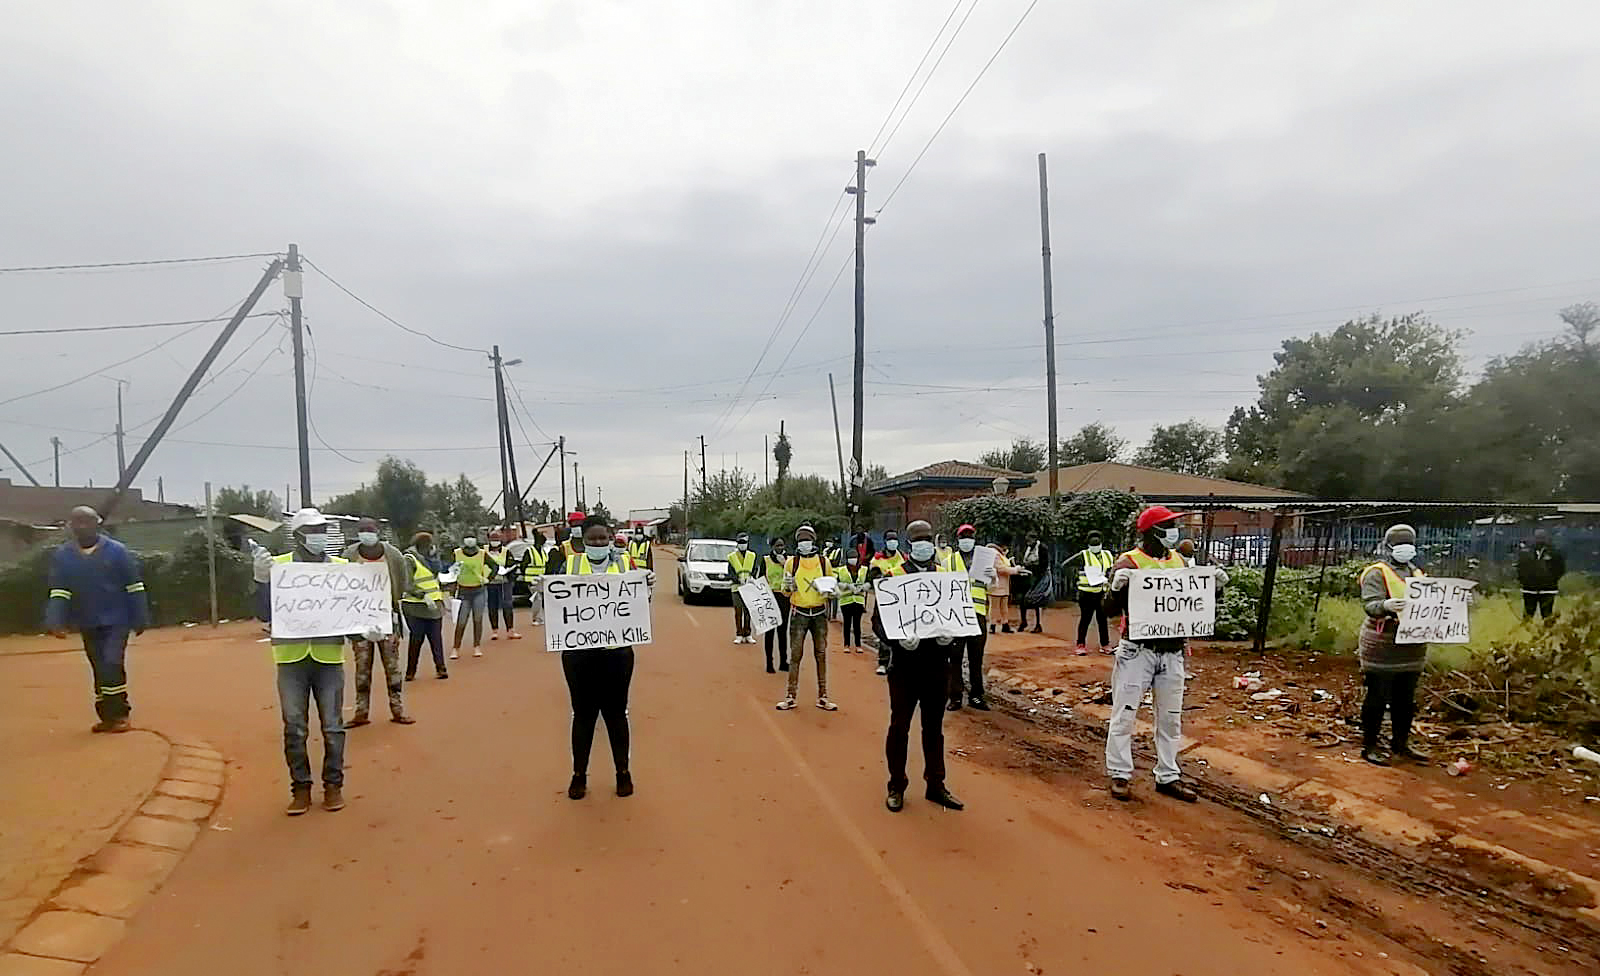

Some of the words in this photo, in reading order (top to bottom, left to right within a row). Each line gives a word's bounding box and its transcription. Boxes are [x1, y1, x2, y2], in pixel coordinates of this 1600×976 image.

[277, 569, 388, 592] LOCKDOWN
[548, 580, 610, 600] STAY
[619, 580, 643, 599] AT
[1142, 577, 1184, 592] STAY
[1189, 575, 1210, 590] AT
[347, 595, 389, 613] KILL
[756, 583, 775, 610] STAY
[878, 578, 942, 607] STAY
[949, 579, 969, 603] AT
[1154, 596, 1204, 612] HOME
[1410, 581, 1447, 604] STAY
[1451, 585, 1472, 602] AT
[563, 601, 631, 624] HOME
[898, 604, 977, 637] HOME
[1410, 604, 1451, 620] HOME
